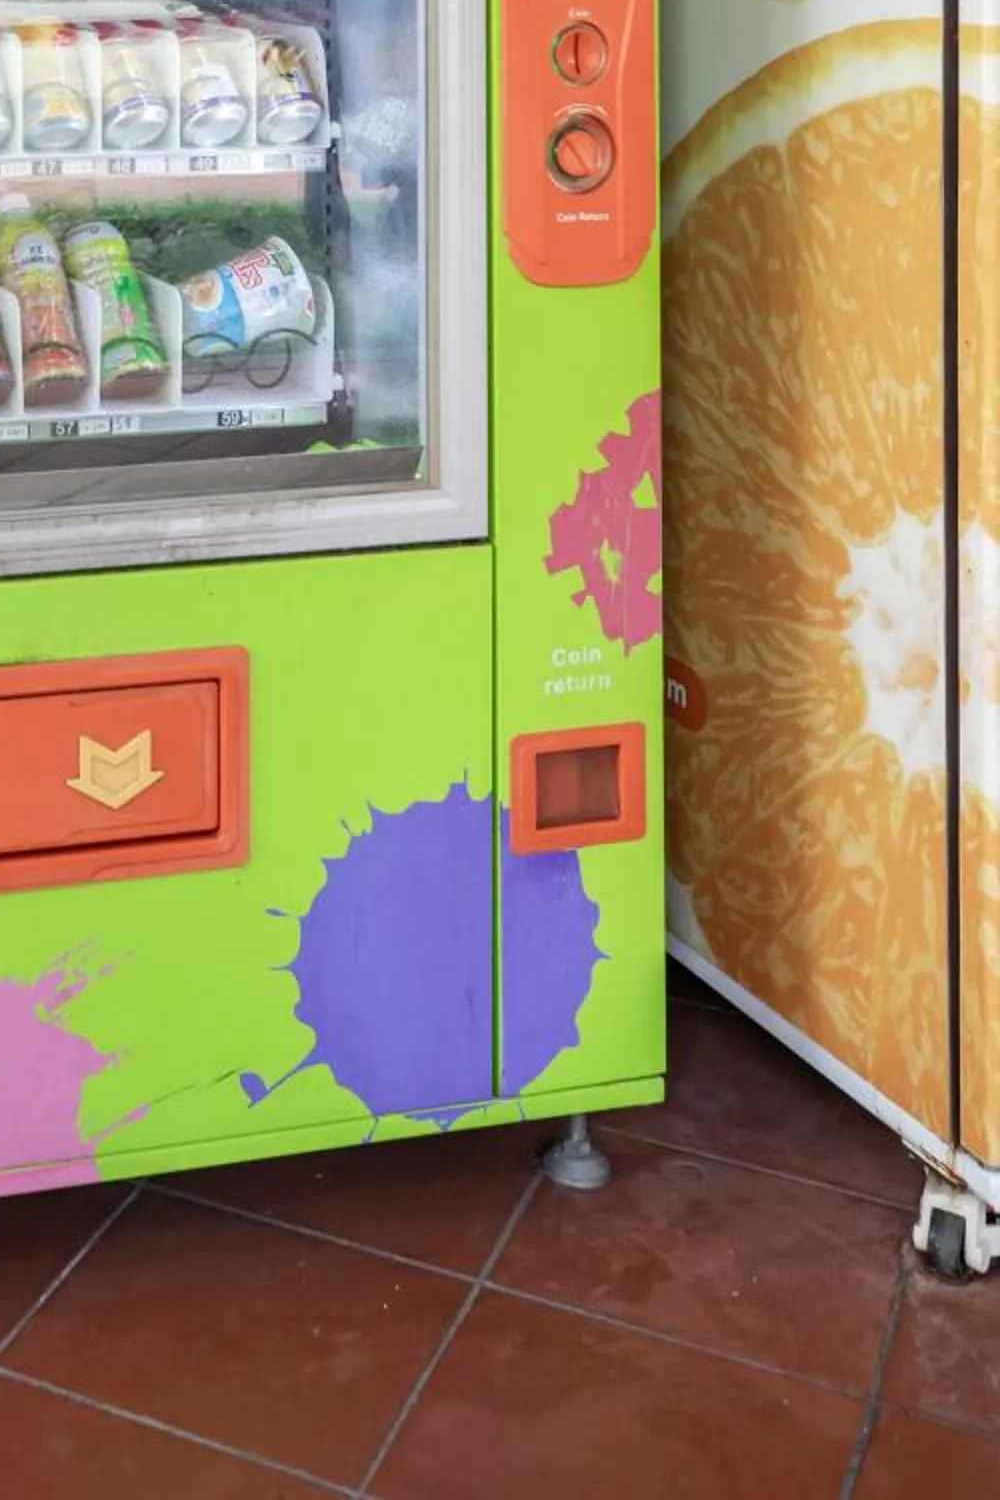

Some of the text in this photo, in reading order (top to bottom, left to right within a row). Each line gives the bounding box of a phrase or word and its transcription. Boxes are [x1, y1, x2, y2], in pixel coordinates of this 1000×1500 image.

[222, 411, 240, 425] 59
[55, 421, 74, 436] 57
[550, 647, 602, 668] Coin
[543, 674, 611, 696] return
